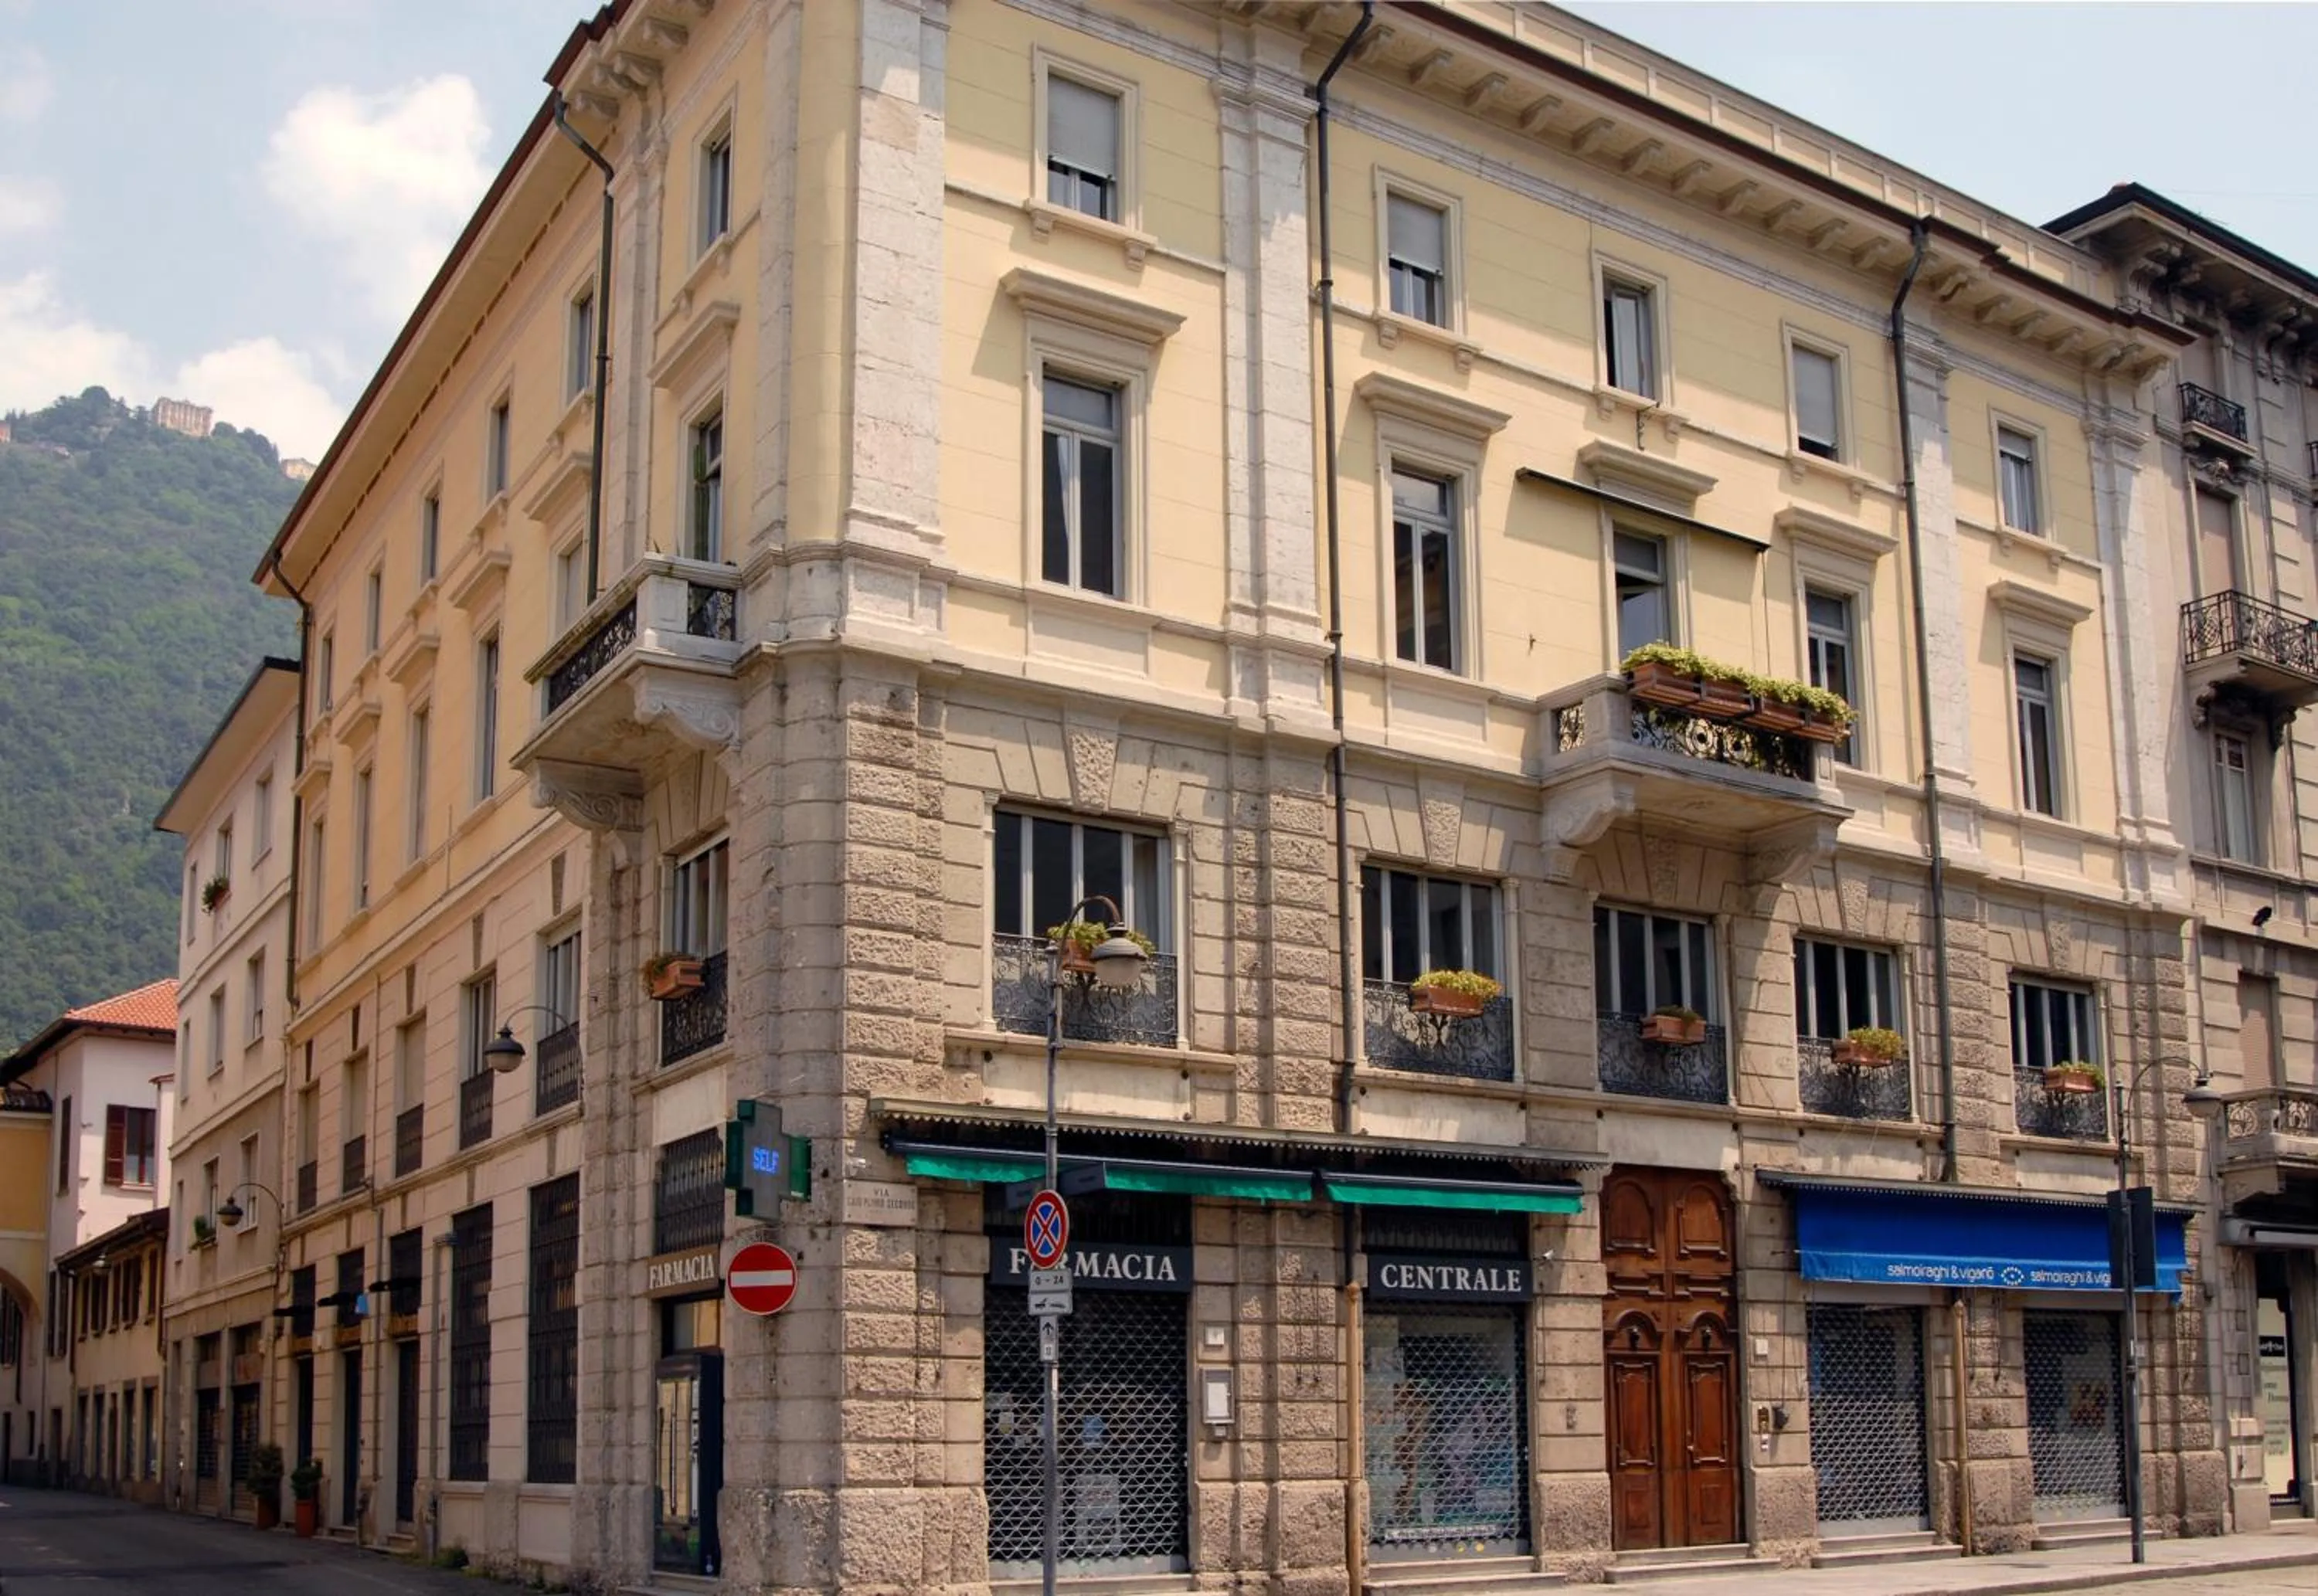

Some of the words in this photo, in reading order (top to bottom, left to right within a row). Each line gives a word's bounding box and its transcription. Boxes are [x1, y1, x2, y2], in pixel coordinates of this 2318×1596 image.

[753, 1147, 779, 1173] SELF
[873, 1188, 889, 1197] VIA
[649, 1253, 715, 1290] FARMACIA
[1009, 1248, 1177, 1281] FMACIA
[1381, 1263, 1521, 1292] CENTRALE
[1887, 1264, 1949, 1282] salmoiraghi
[1951, 1265, 1959, 1279] &
[2086, 1271, 2094, 1284] &
